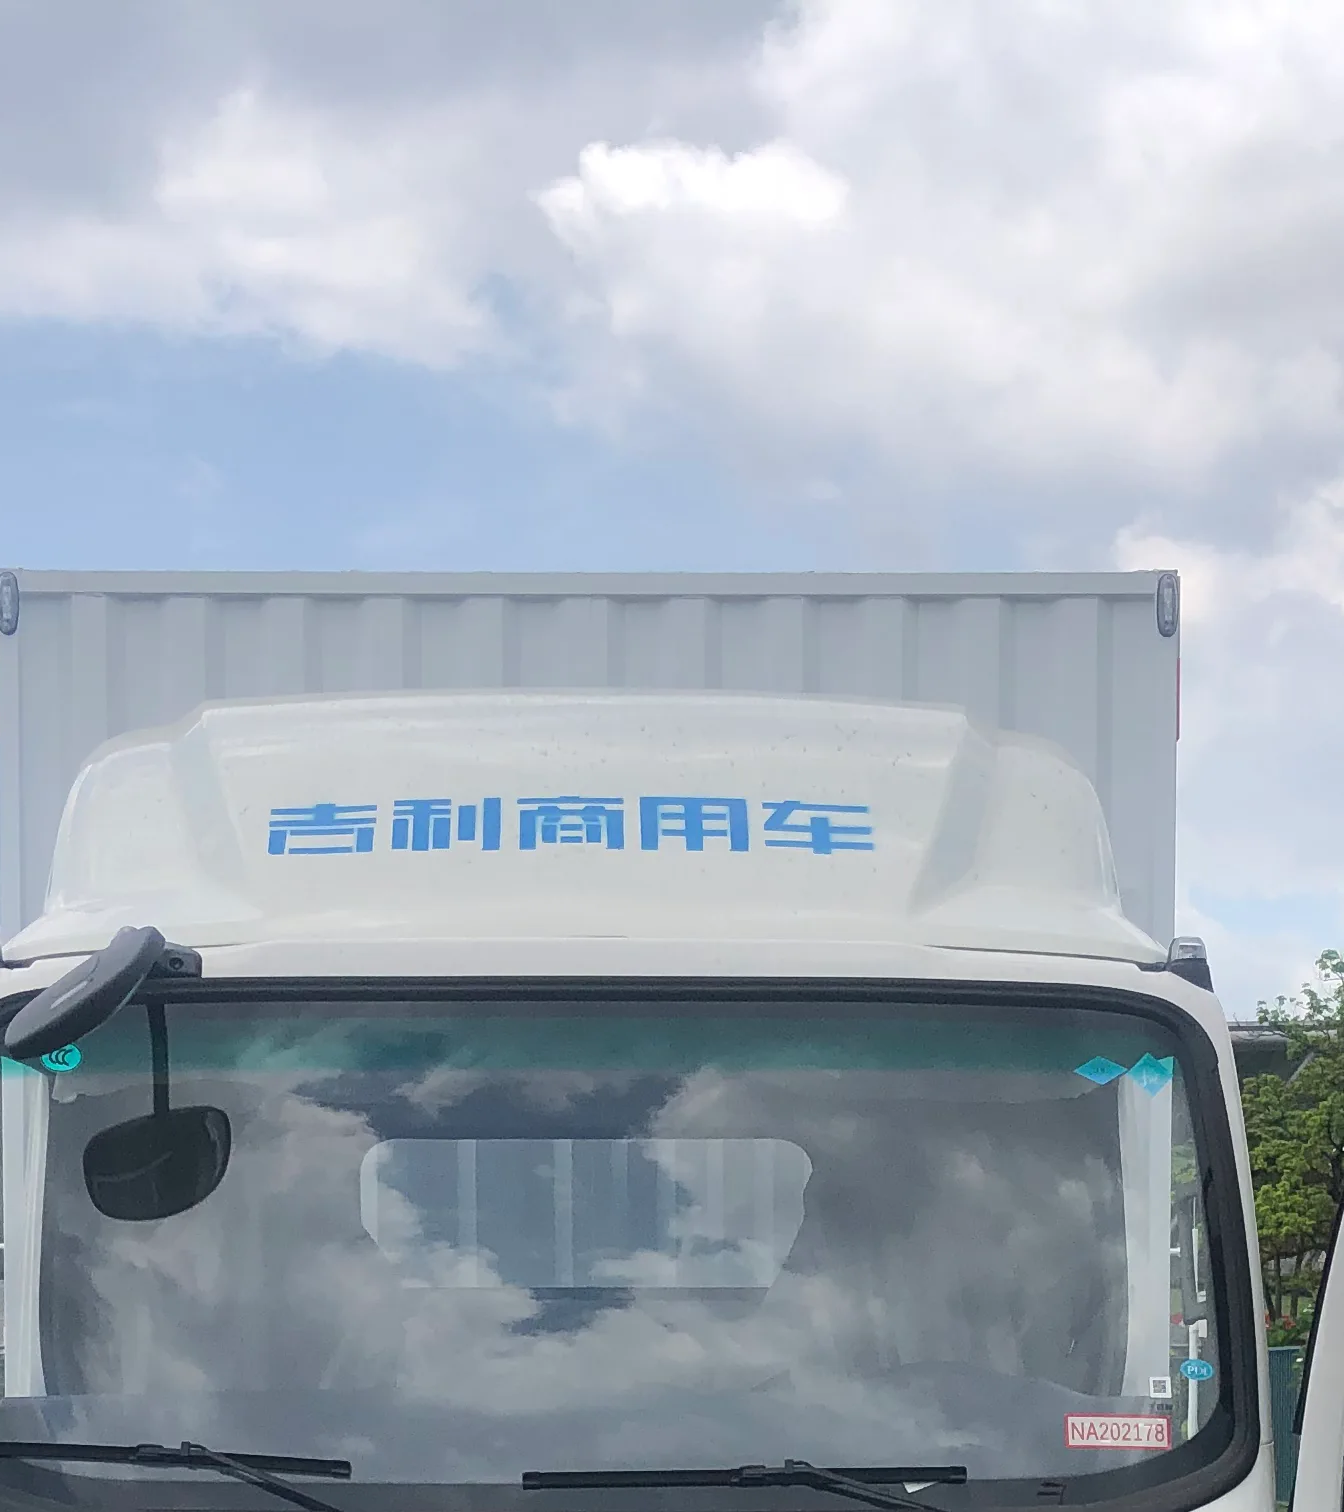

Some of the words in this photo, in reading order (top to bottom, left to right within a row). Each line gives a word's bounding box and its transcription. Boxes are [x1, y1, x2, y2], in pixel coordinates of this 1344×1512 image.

[268, 796, 875, 856] 吉利商用车
[1070, 1421, 1165, 1443] NA202178
